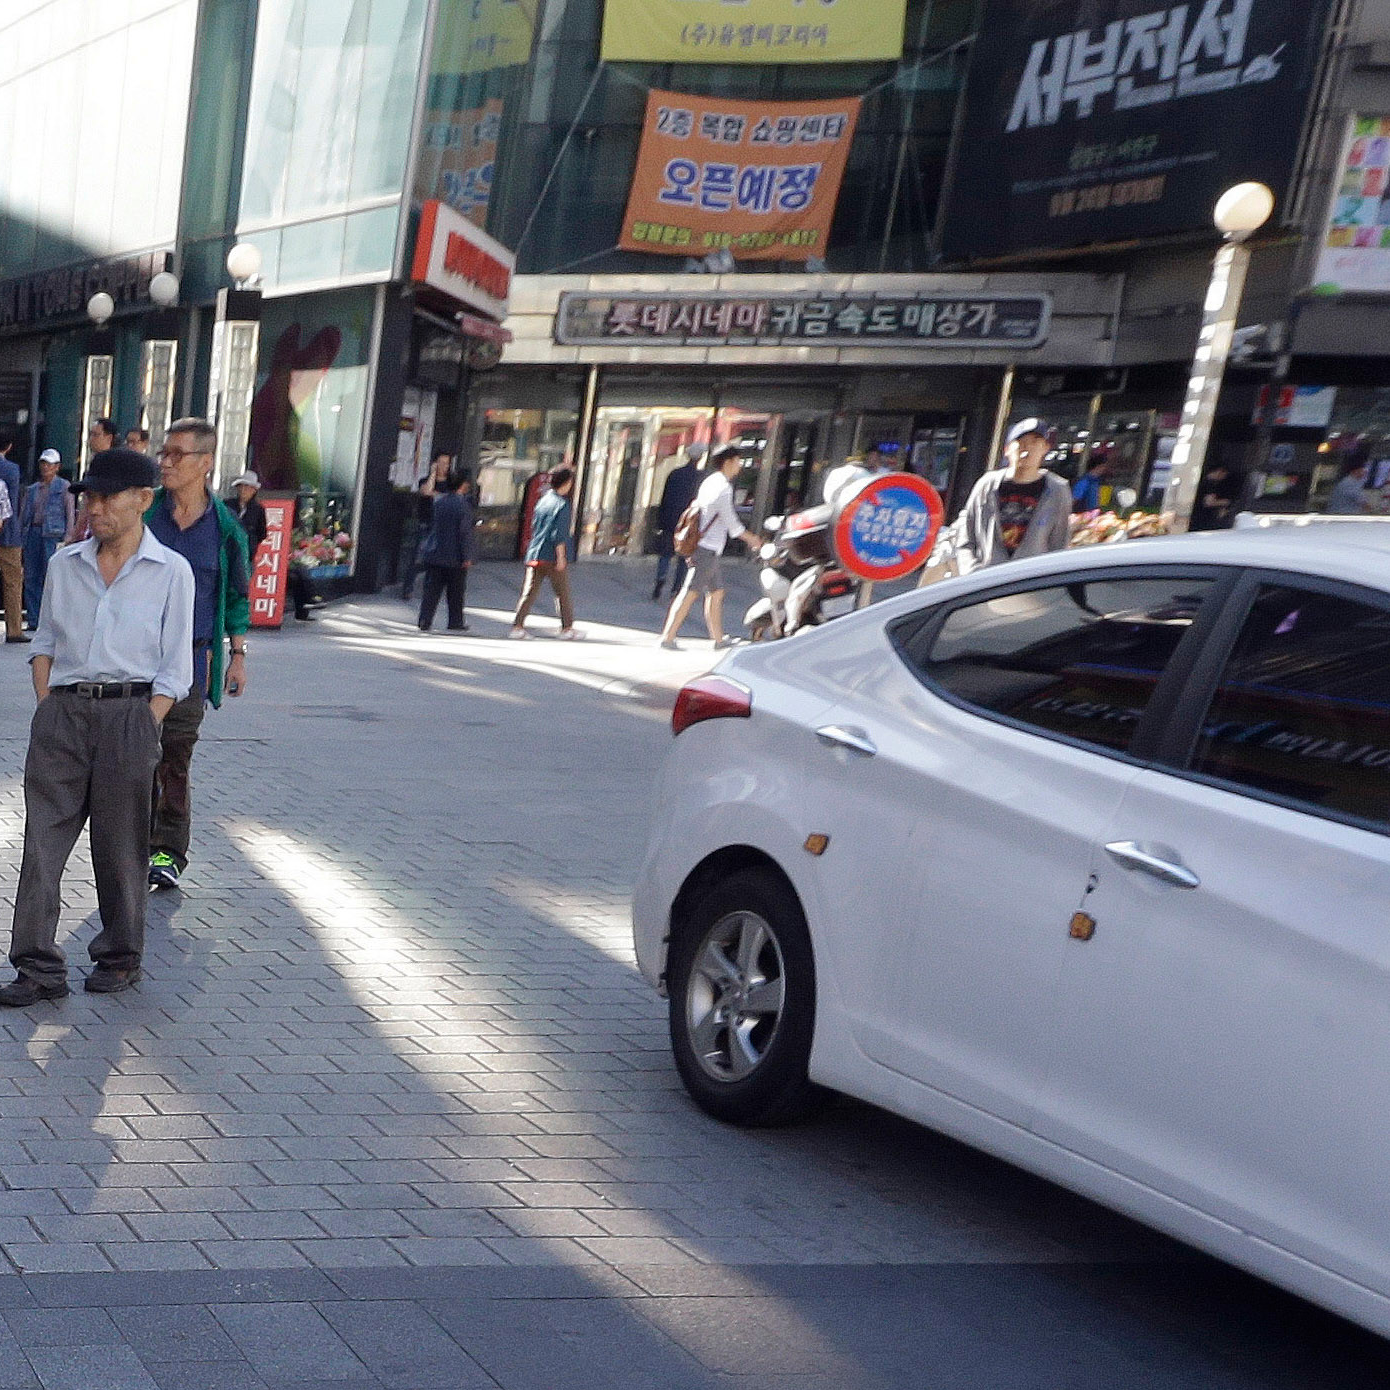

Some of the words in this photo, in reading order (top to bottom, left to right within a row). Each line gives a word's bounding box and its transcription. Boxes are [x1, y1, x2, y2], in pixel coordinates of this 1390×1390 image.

[1005, 0, 1250, 134] 서부전선
[655, 106, 694, 139] 2층
[659, 158, 823, 214] 오픈예정
[608, 299, 766, 336] 롯데시네마
[769, 300, 998, 338] 귀금속도매상가
[254, 507, 285, 619] 롯데시네마
